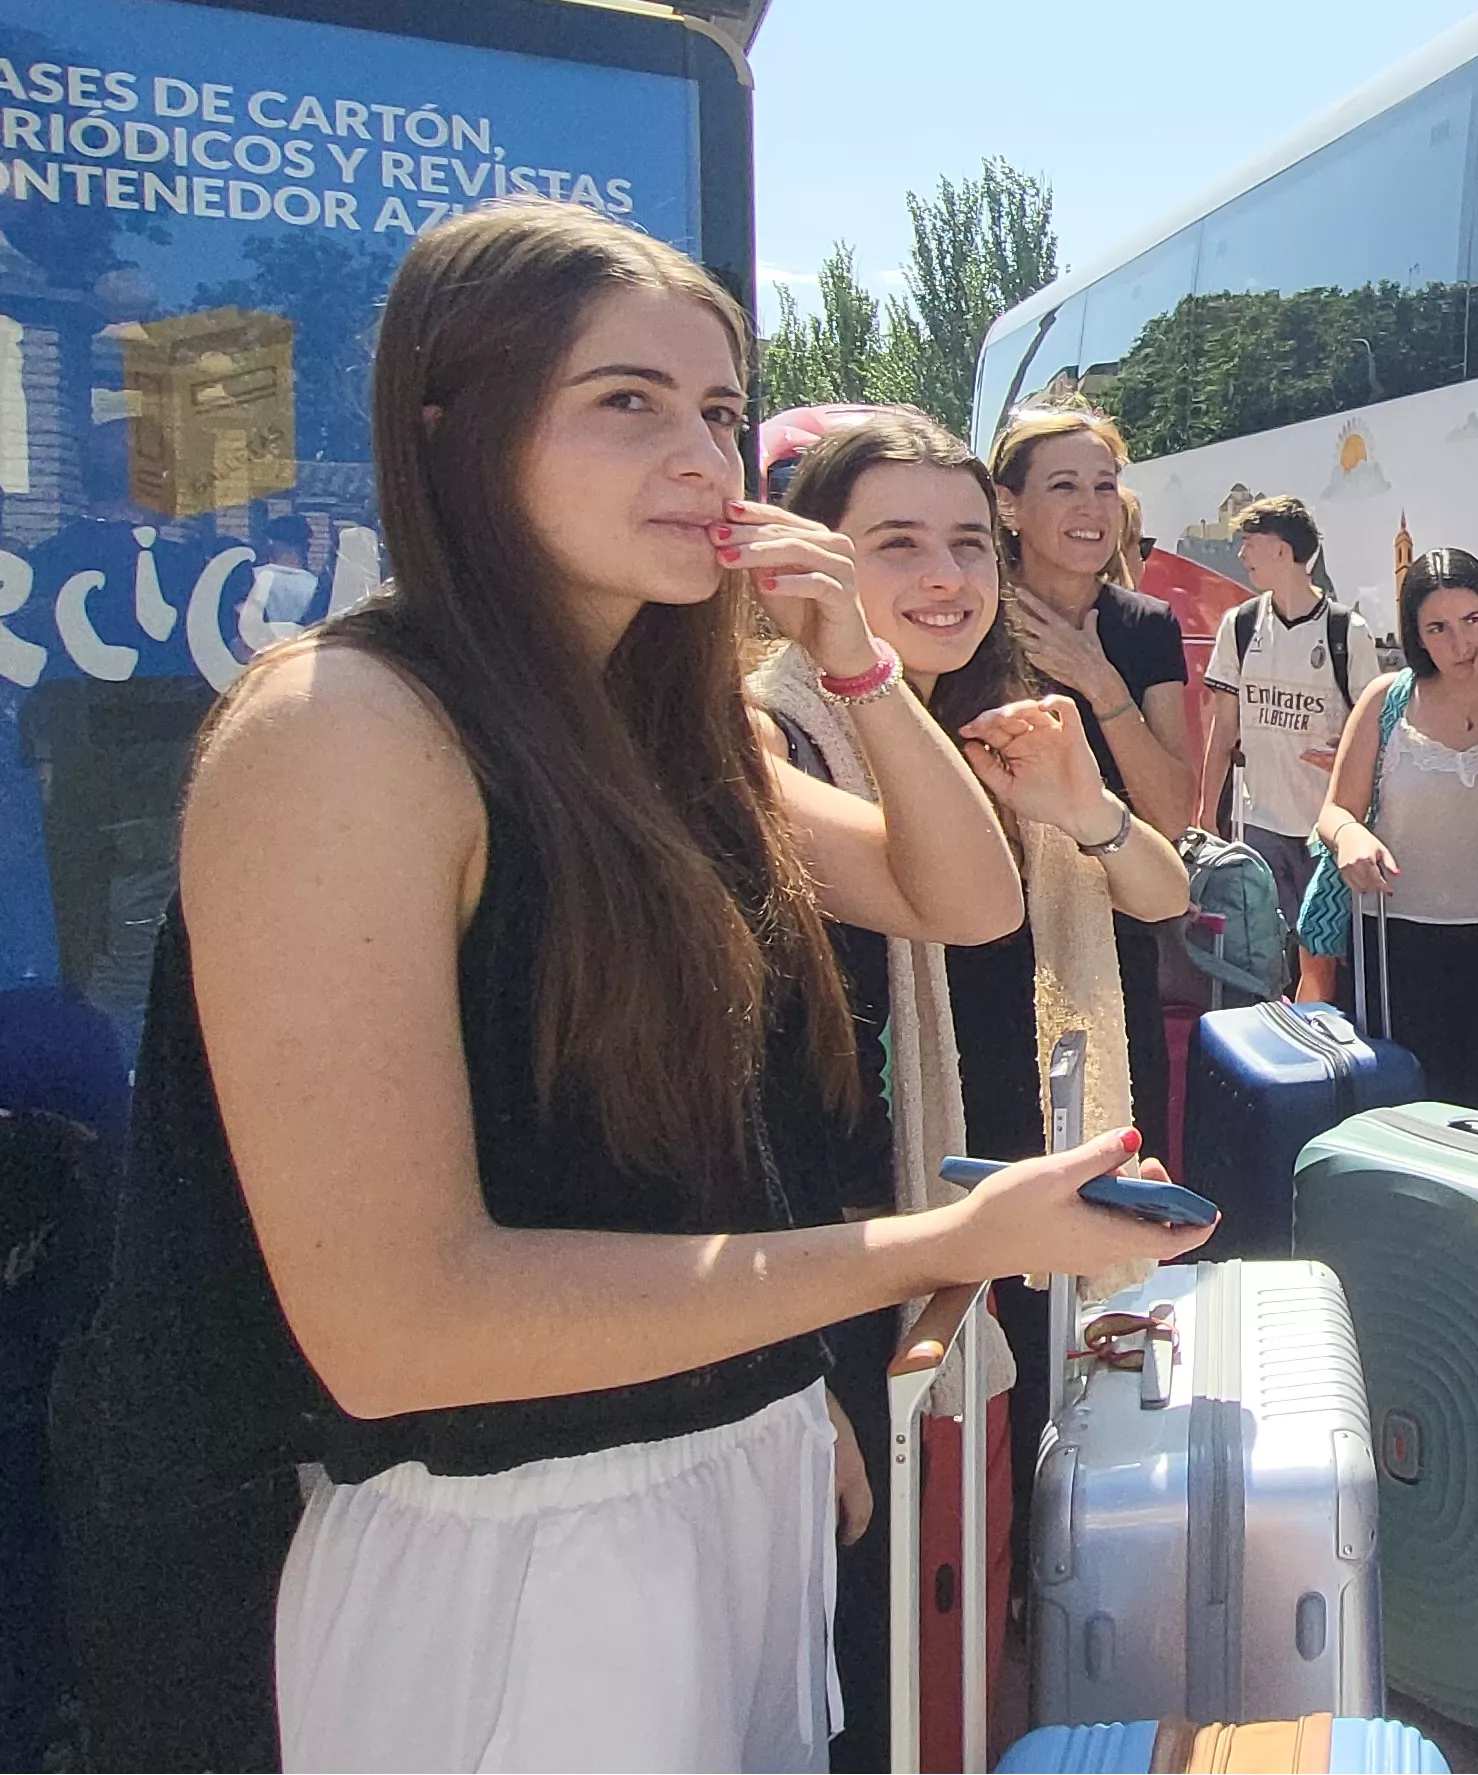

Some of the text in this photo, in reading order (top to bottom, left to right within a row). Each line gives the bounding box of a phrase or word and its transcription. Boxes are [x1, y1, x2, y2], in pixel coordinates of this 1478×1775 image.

[153, 77, 235, 124] DE
[248, 91, 506, 162] CARTÓN,
[0, 158, 464, 236] NTENEDOR AZ
[327, 143, 368, 184] Y
[381, 150, 634, 215] REVISTAS
